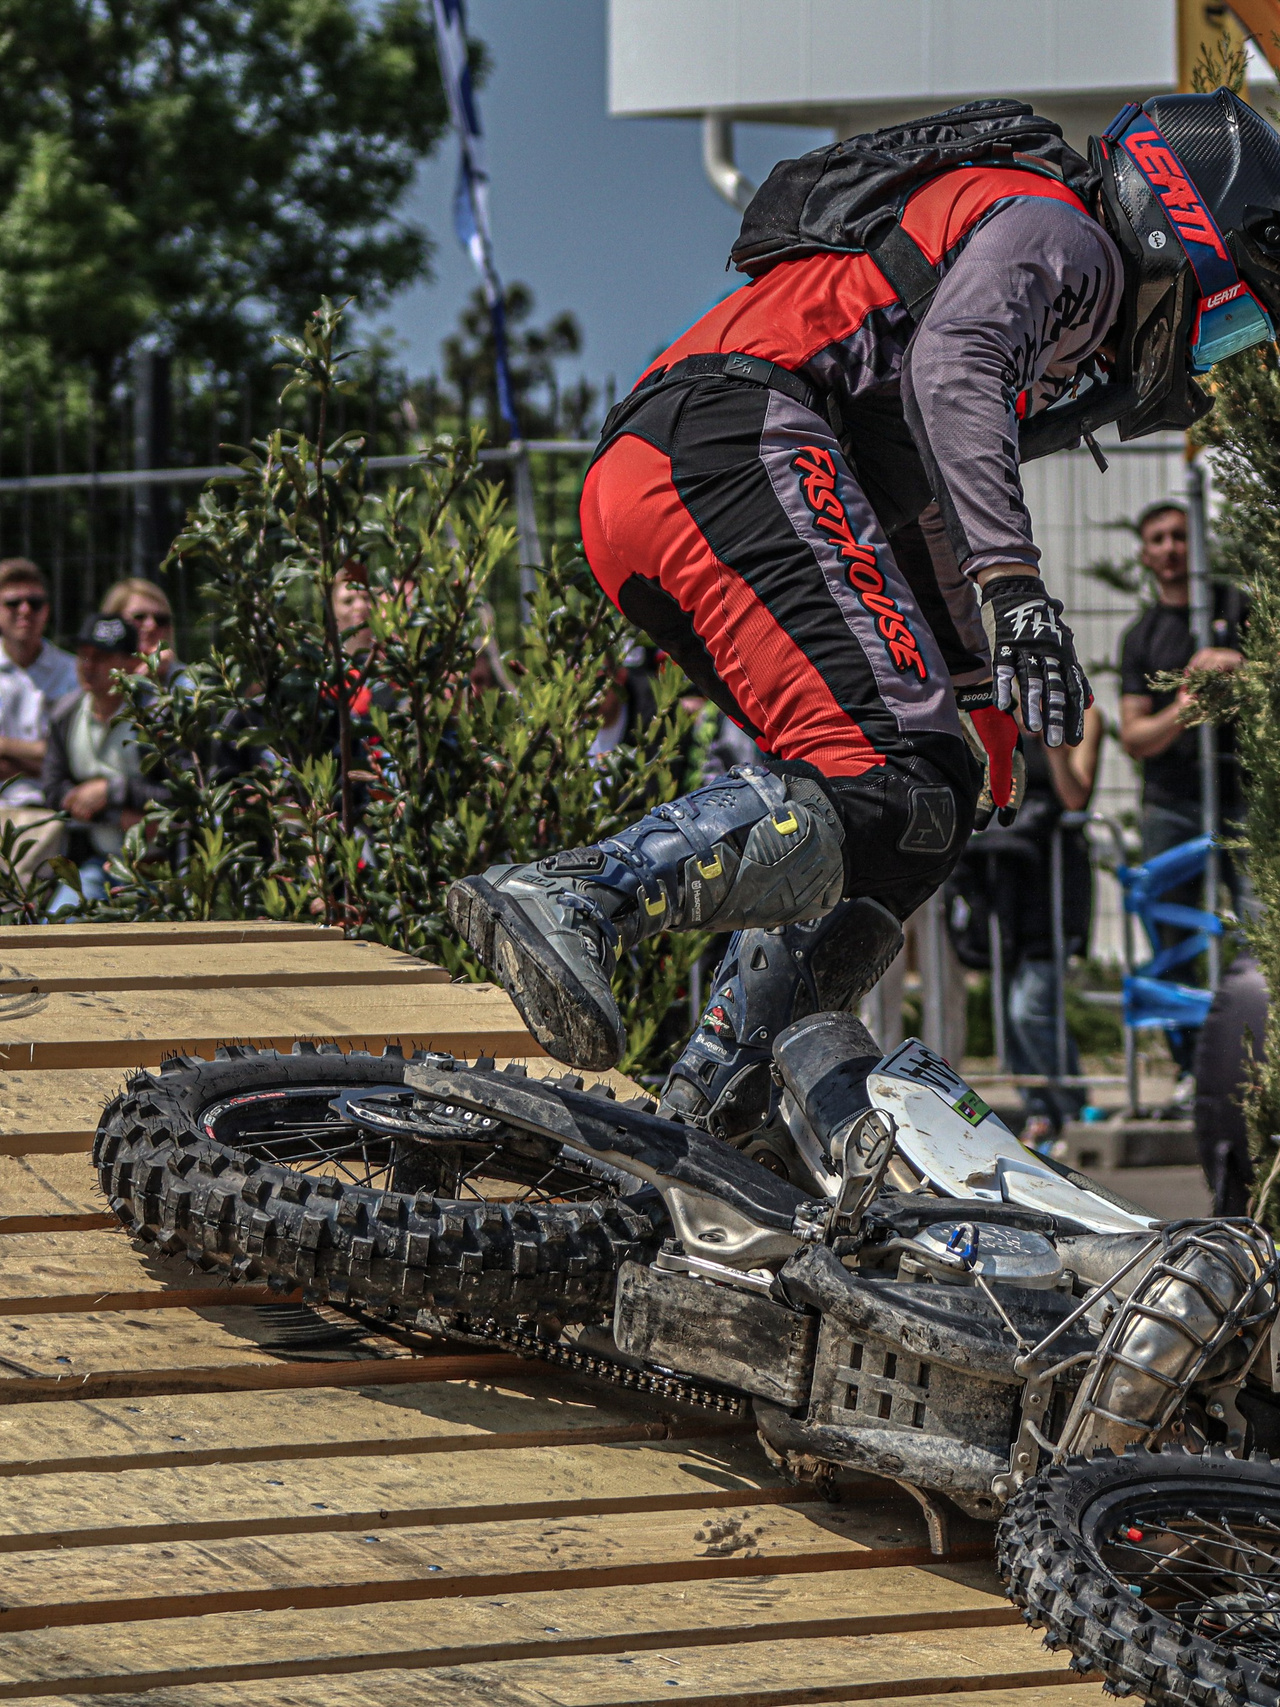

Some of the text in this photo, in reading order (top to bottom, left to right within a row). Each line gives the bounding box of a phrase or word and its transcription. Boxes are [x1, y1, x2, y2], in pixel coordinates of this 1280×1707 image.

[1124, 130, 1229, 261] LEATT
[1207, 284, 1241, 309] LEATT
[794, 445, 927, 680] FASTHOUSE
